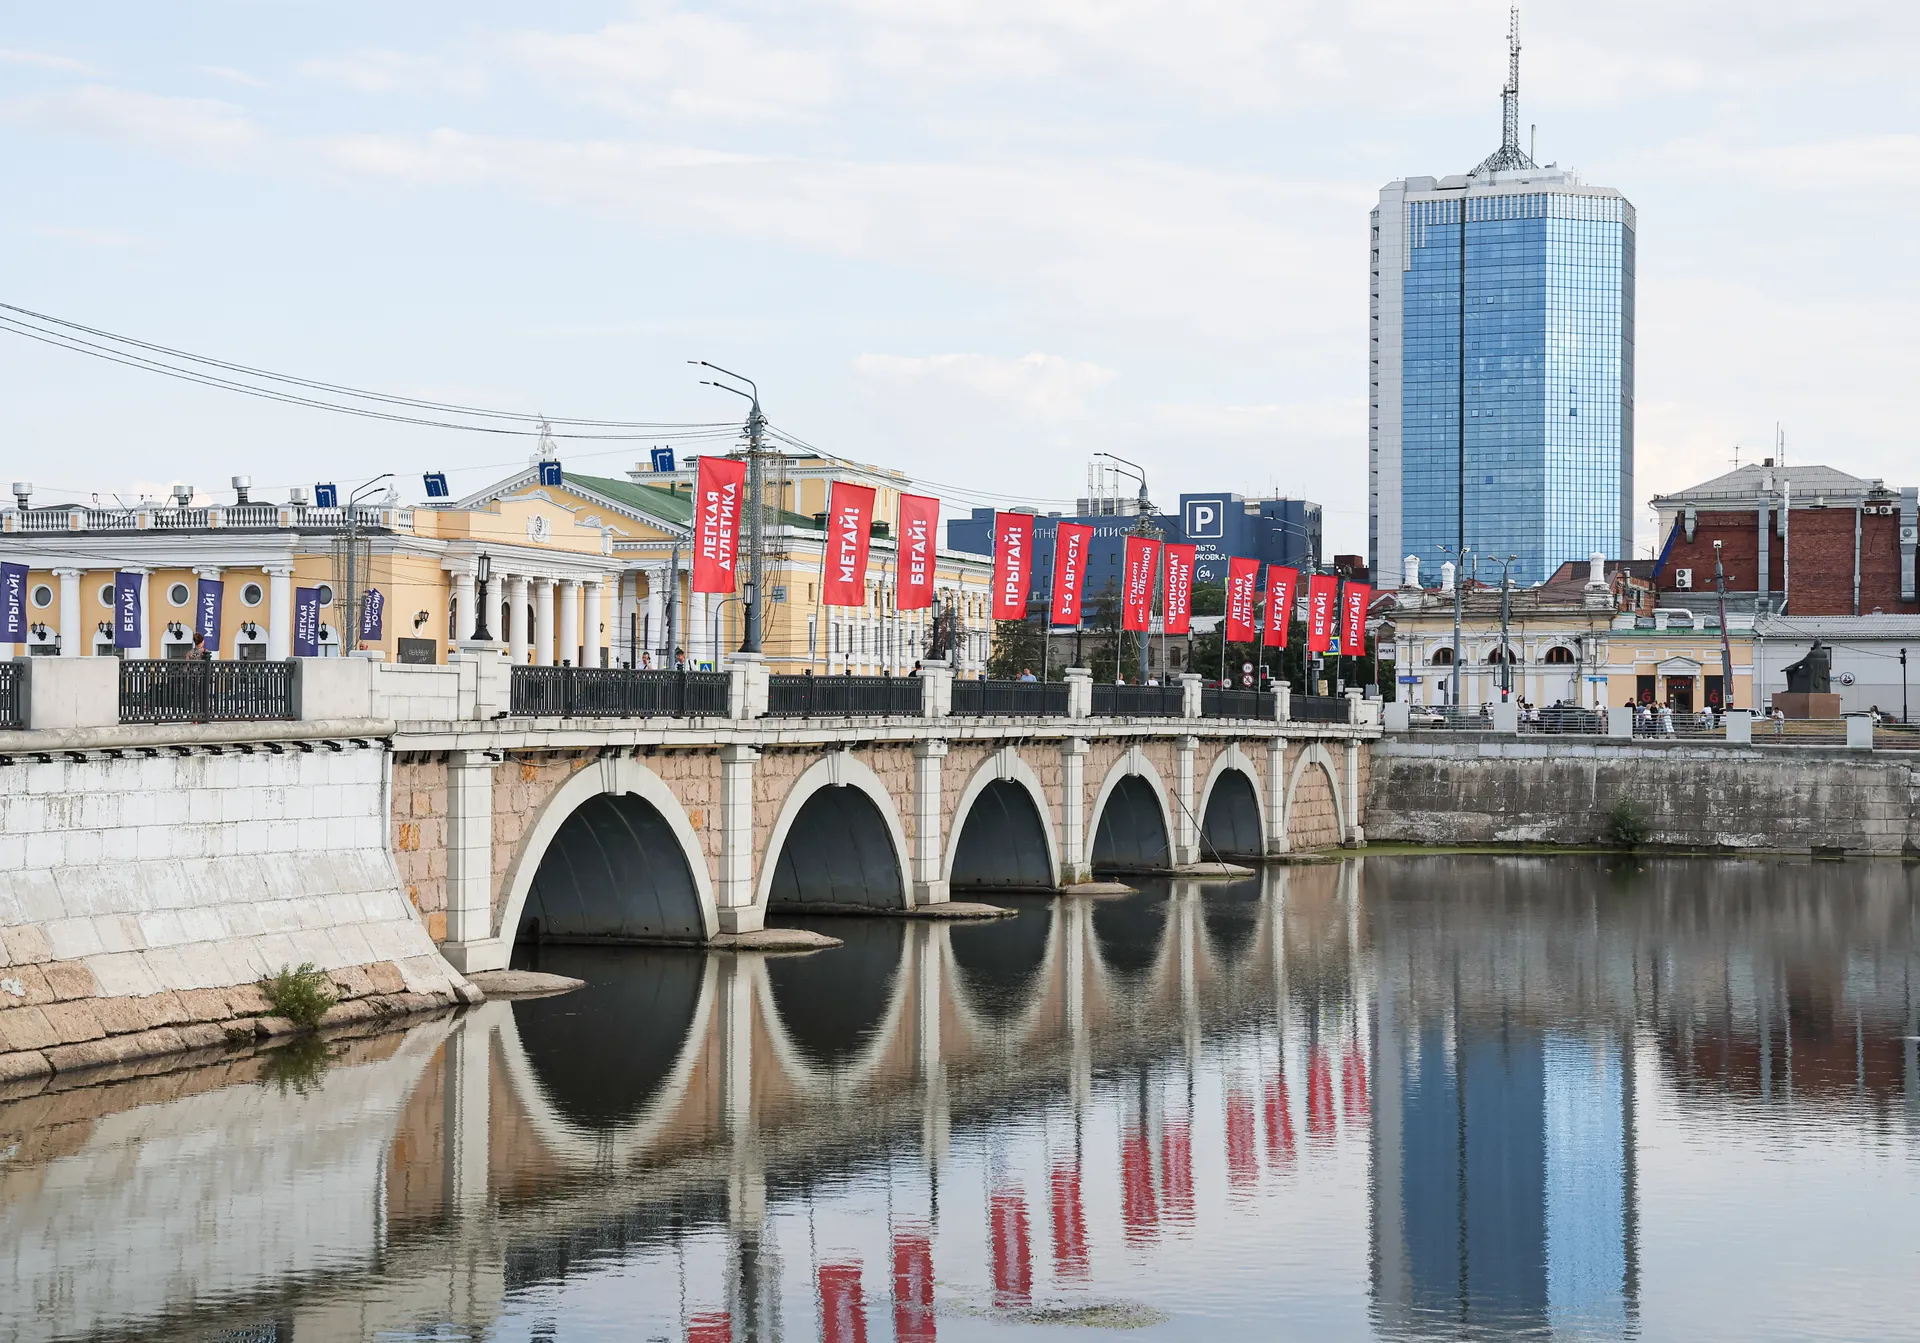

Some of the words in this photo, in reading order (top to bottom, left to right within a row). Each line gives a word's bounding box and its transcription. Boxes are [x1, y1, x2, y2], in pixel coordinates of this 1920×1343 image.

[703, 491, 719, 559] ЛЕГКАЯ
[718, 482, 736, 571] АТЛЕТИКА
[838, 507, 860, 582] МЕТАЙ!
[907, 519, 927, 585] БЕГАЙ!
[1003, 527, 1022, 606] ПРЫГАЙ!
[1064, 534, 1080, 590] АВГУСТА
[1200, 570, 1211, 578] 24
[6, 573, 20, 633] ПРЫГАЙ!
[1129, 562, 1139, 605] СТАДИОН
[1168, 552, 1179, 625] ЧЕМПИОНАТ
[1178, 565, 1189, 614] РОССИИ
[1232, 578, 1244, 620] ЛЕГКАЯ
[1242, 573, 1254, 628] АТЛЕТИКА
[1273, 582, 1287, 631] МЕТАЙ!
[121, 588, 135, 632] БЕГАЙ!
[203, 593, 216, 637] МЕТАЙ!
[299, 605, 308, 640] ЛЕГКАЯ
[307, 599, 317, 646] АТЛЕТИКА
[1314, 592, 1327, 635] БЕГАЙ!
[1349, 592, 1362, 647] ПРЫГАЙ!
